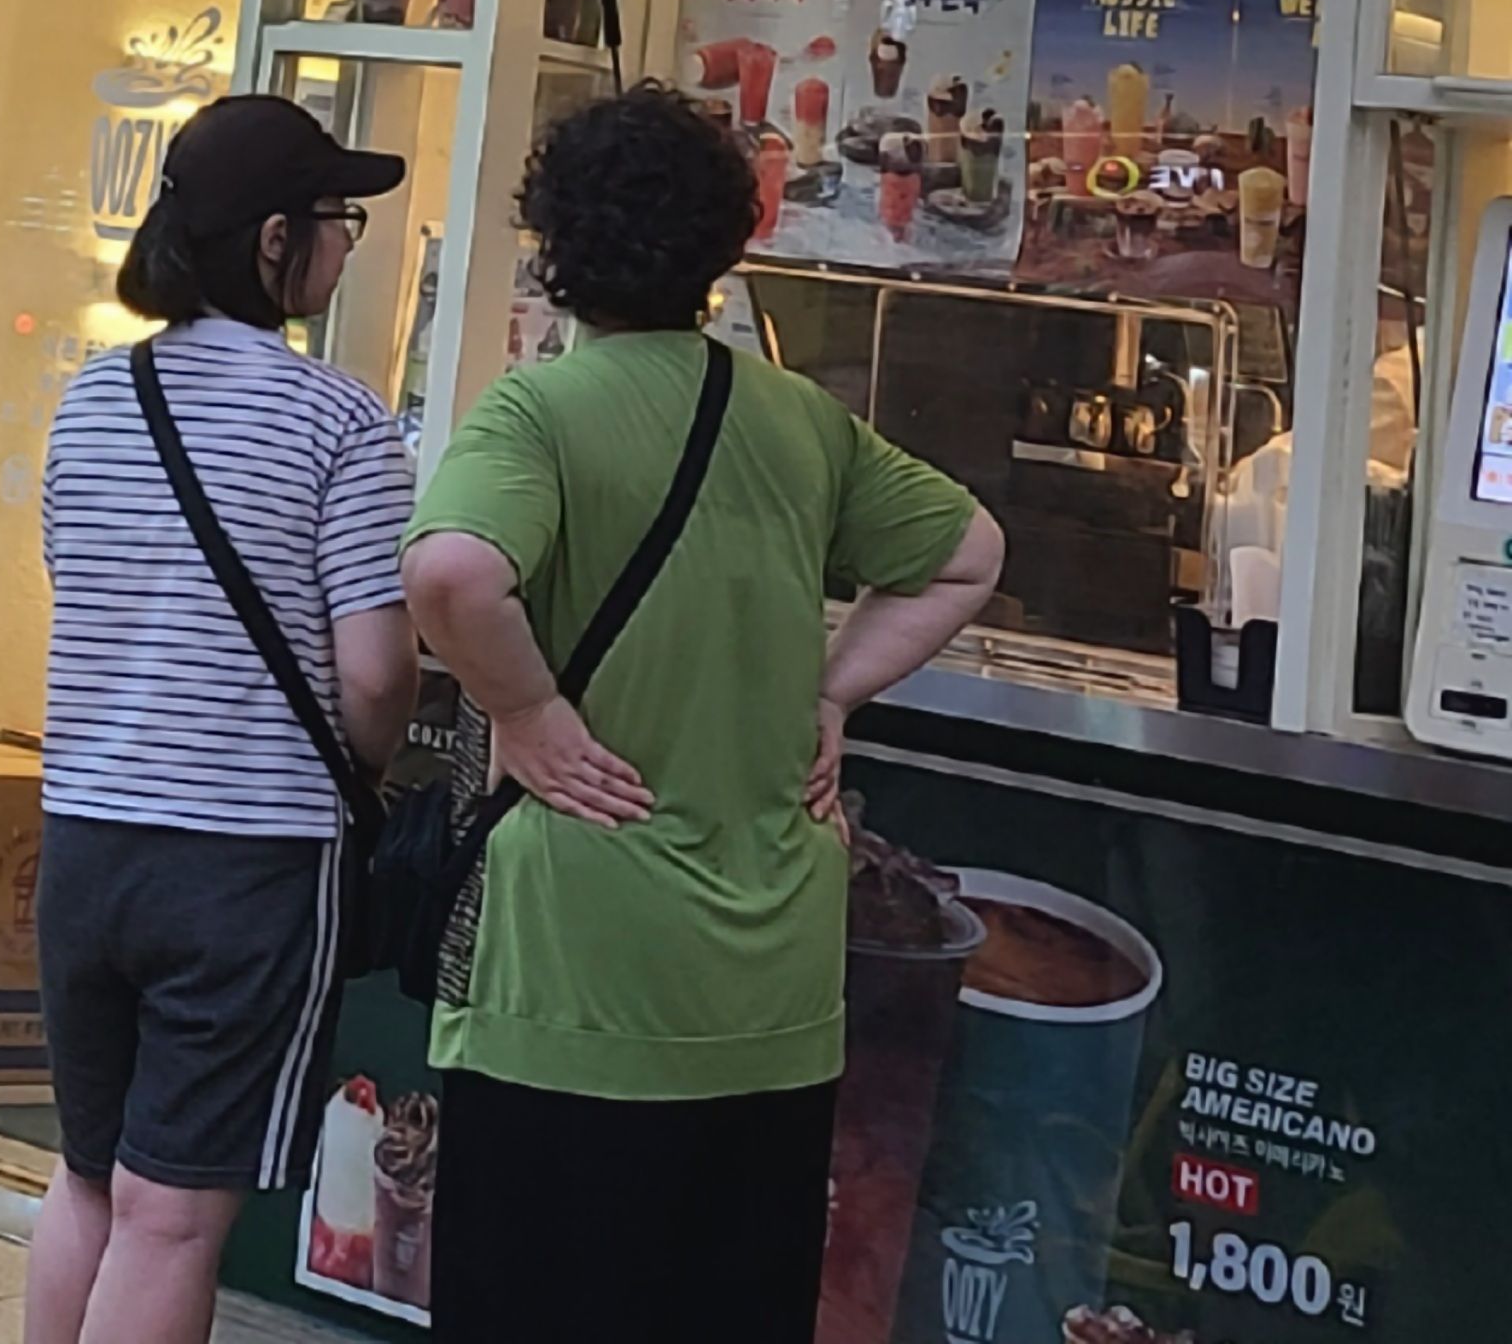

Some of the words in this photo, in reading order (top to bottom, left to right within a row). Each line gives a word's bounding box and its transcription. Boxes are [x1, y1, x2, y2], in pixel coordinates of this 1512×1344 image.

[1103, 10, 1160, 39] LIFE
[1185, 1052, 1239, 1089] BIG
[1245, 1068, 1319, 1108] SIZE
[1181, 1086, 1377, 1155] AMERICANO
[1180, 1161, 1254, 1208] HOT
[942, 1258, 1008, 1341] OOZY
[1168, 1221, 1332, 1316] 1,800
[1336, 1283, 1366, 1328] 원
